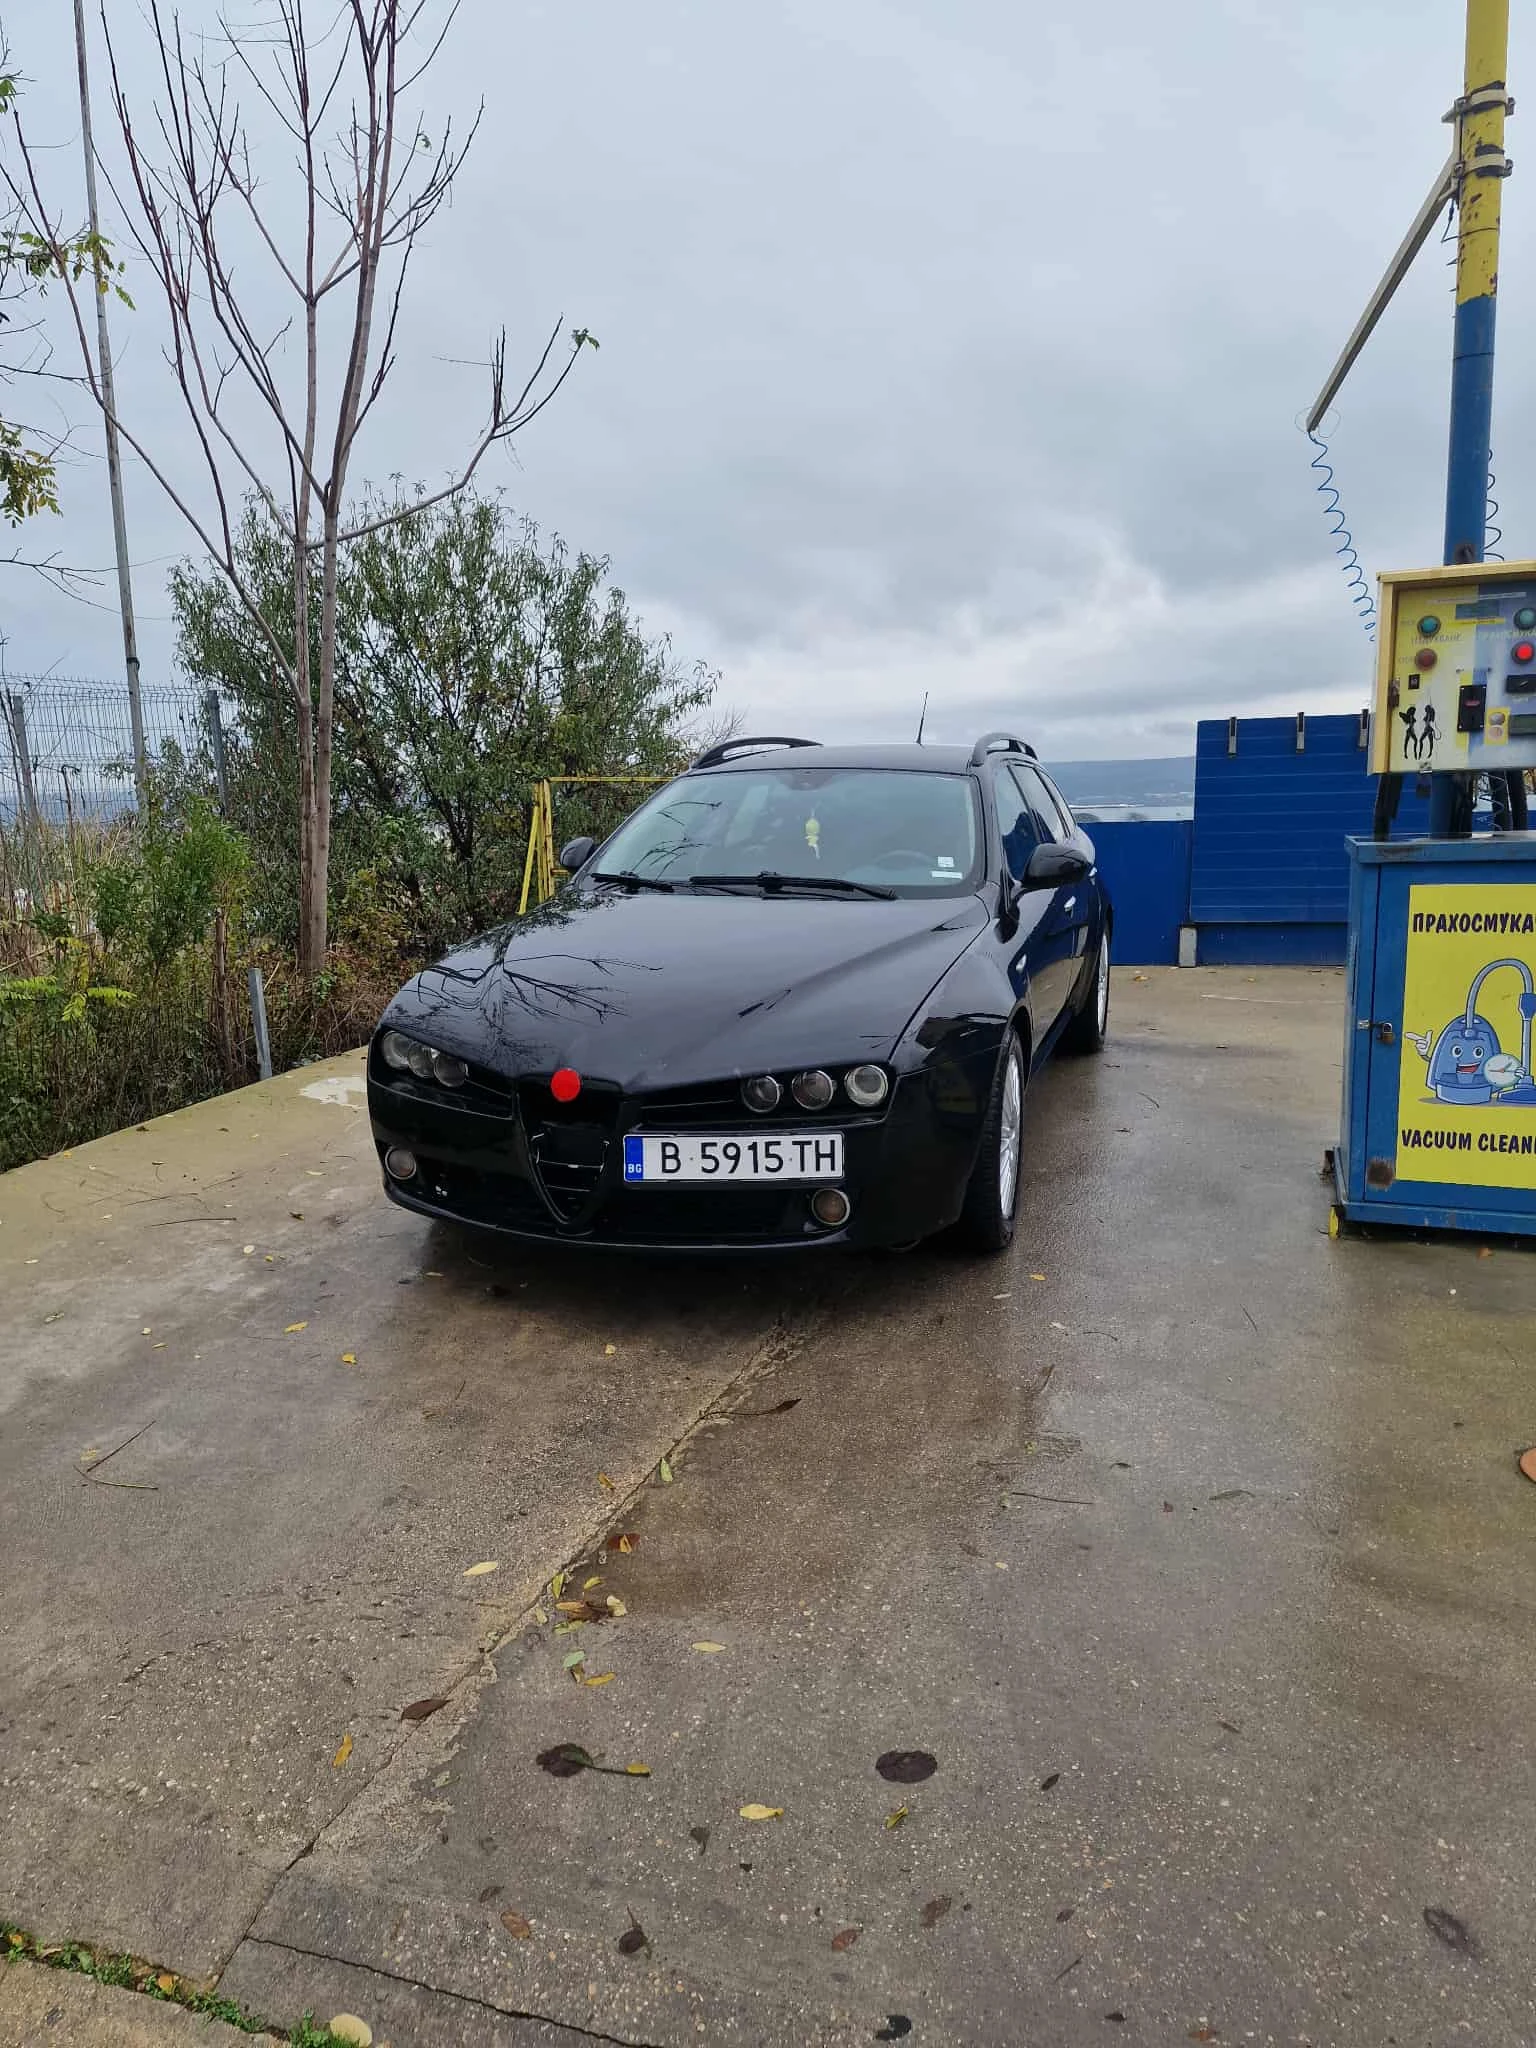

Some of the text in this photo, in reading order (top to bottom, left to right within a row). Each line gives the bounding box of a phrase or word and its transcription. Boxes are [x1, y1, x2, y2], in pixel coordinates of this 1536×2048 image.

[1412, 911, 1536, 934] ПРАХОСМУКА
[1401, 1128, 1536, 1155] VACUUM CLEAN
[627, 1163, 642, 1174] BG
[660, 1139, 836, 1174] B 5915 TH
